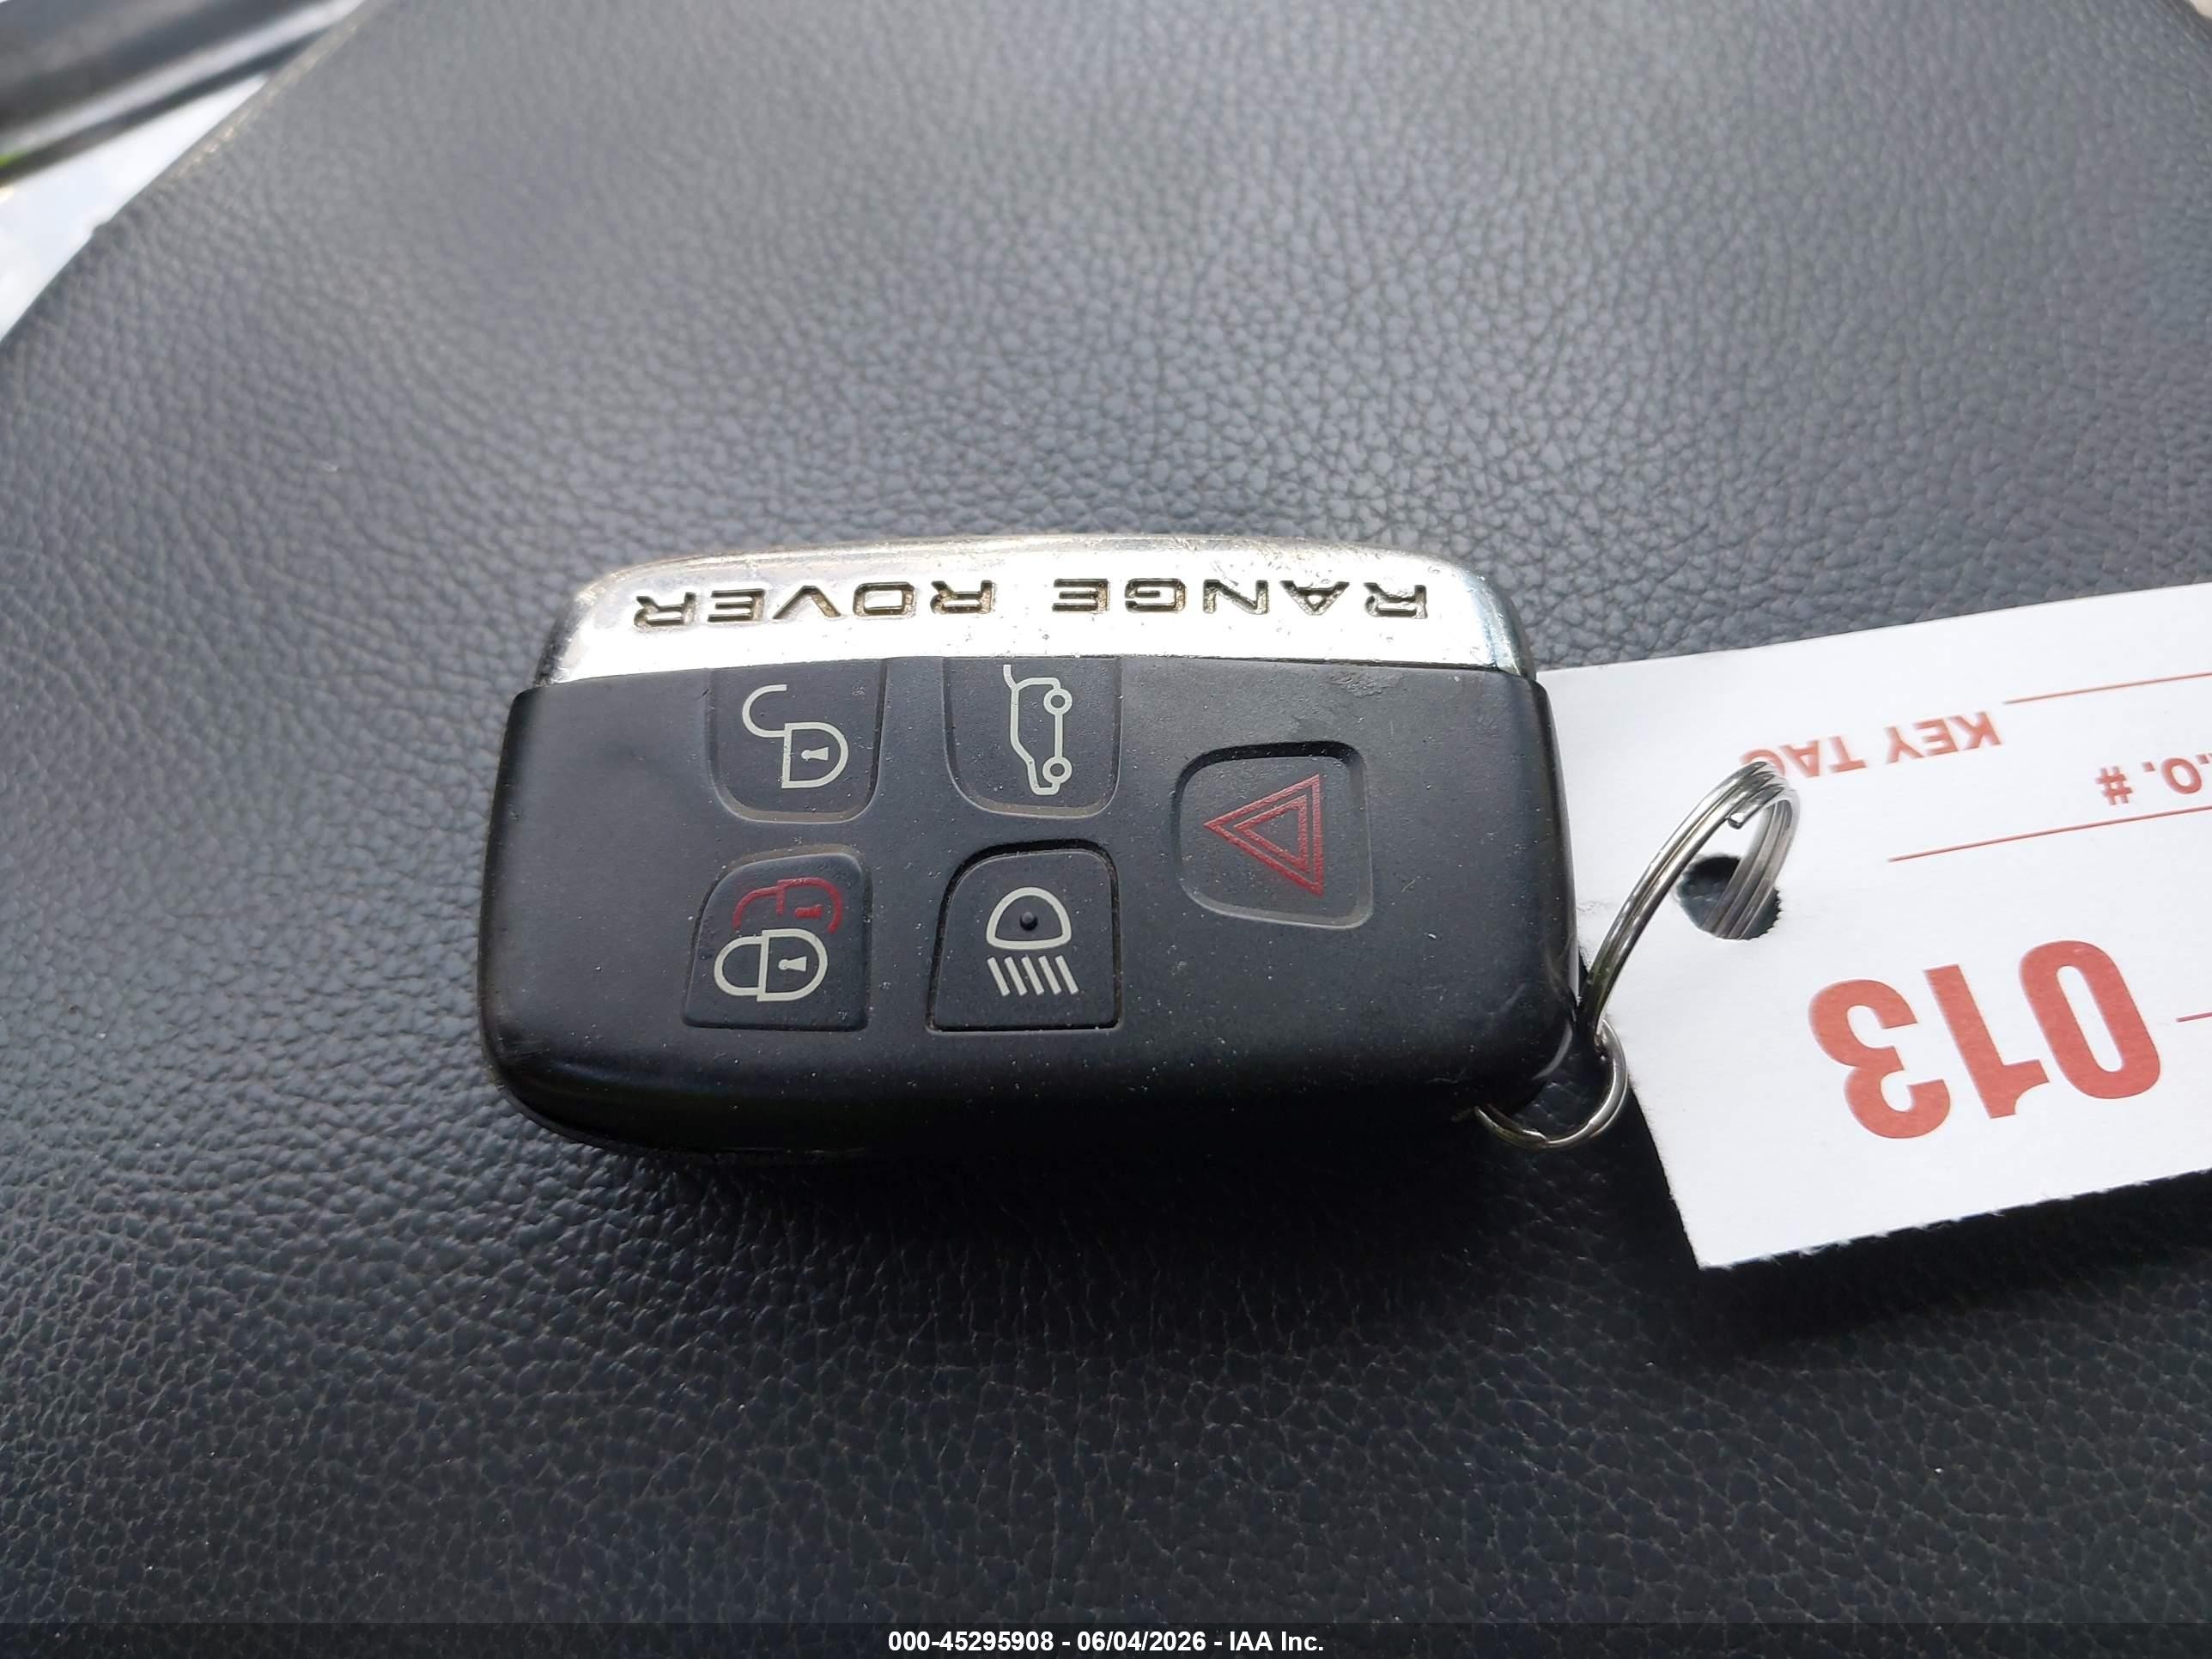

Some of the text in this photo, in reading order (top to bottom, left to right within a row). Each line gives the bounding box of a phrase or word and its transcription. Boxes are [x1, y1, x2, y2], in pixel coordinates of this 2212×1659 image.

[634, 579, 1428, 628] RANGE ROVER
[1885, 712, 2002, 763] KEY
[2095, 753, 2212, 805] .O. #
[1810, 940, 2162, 1139] 013
